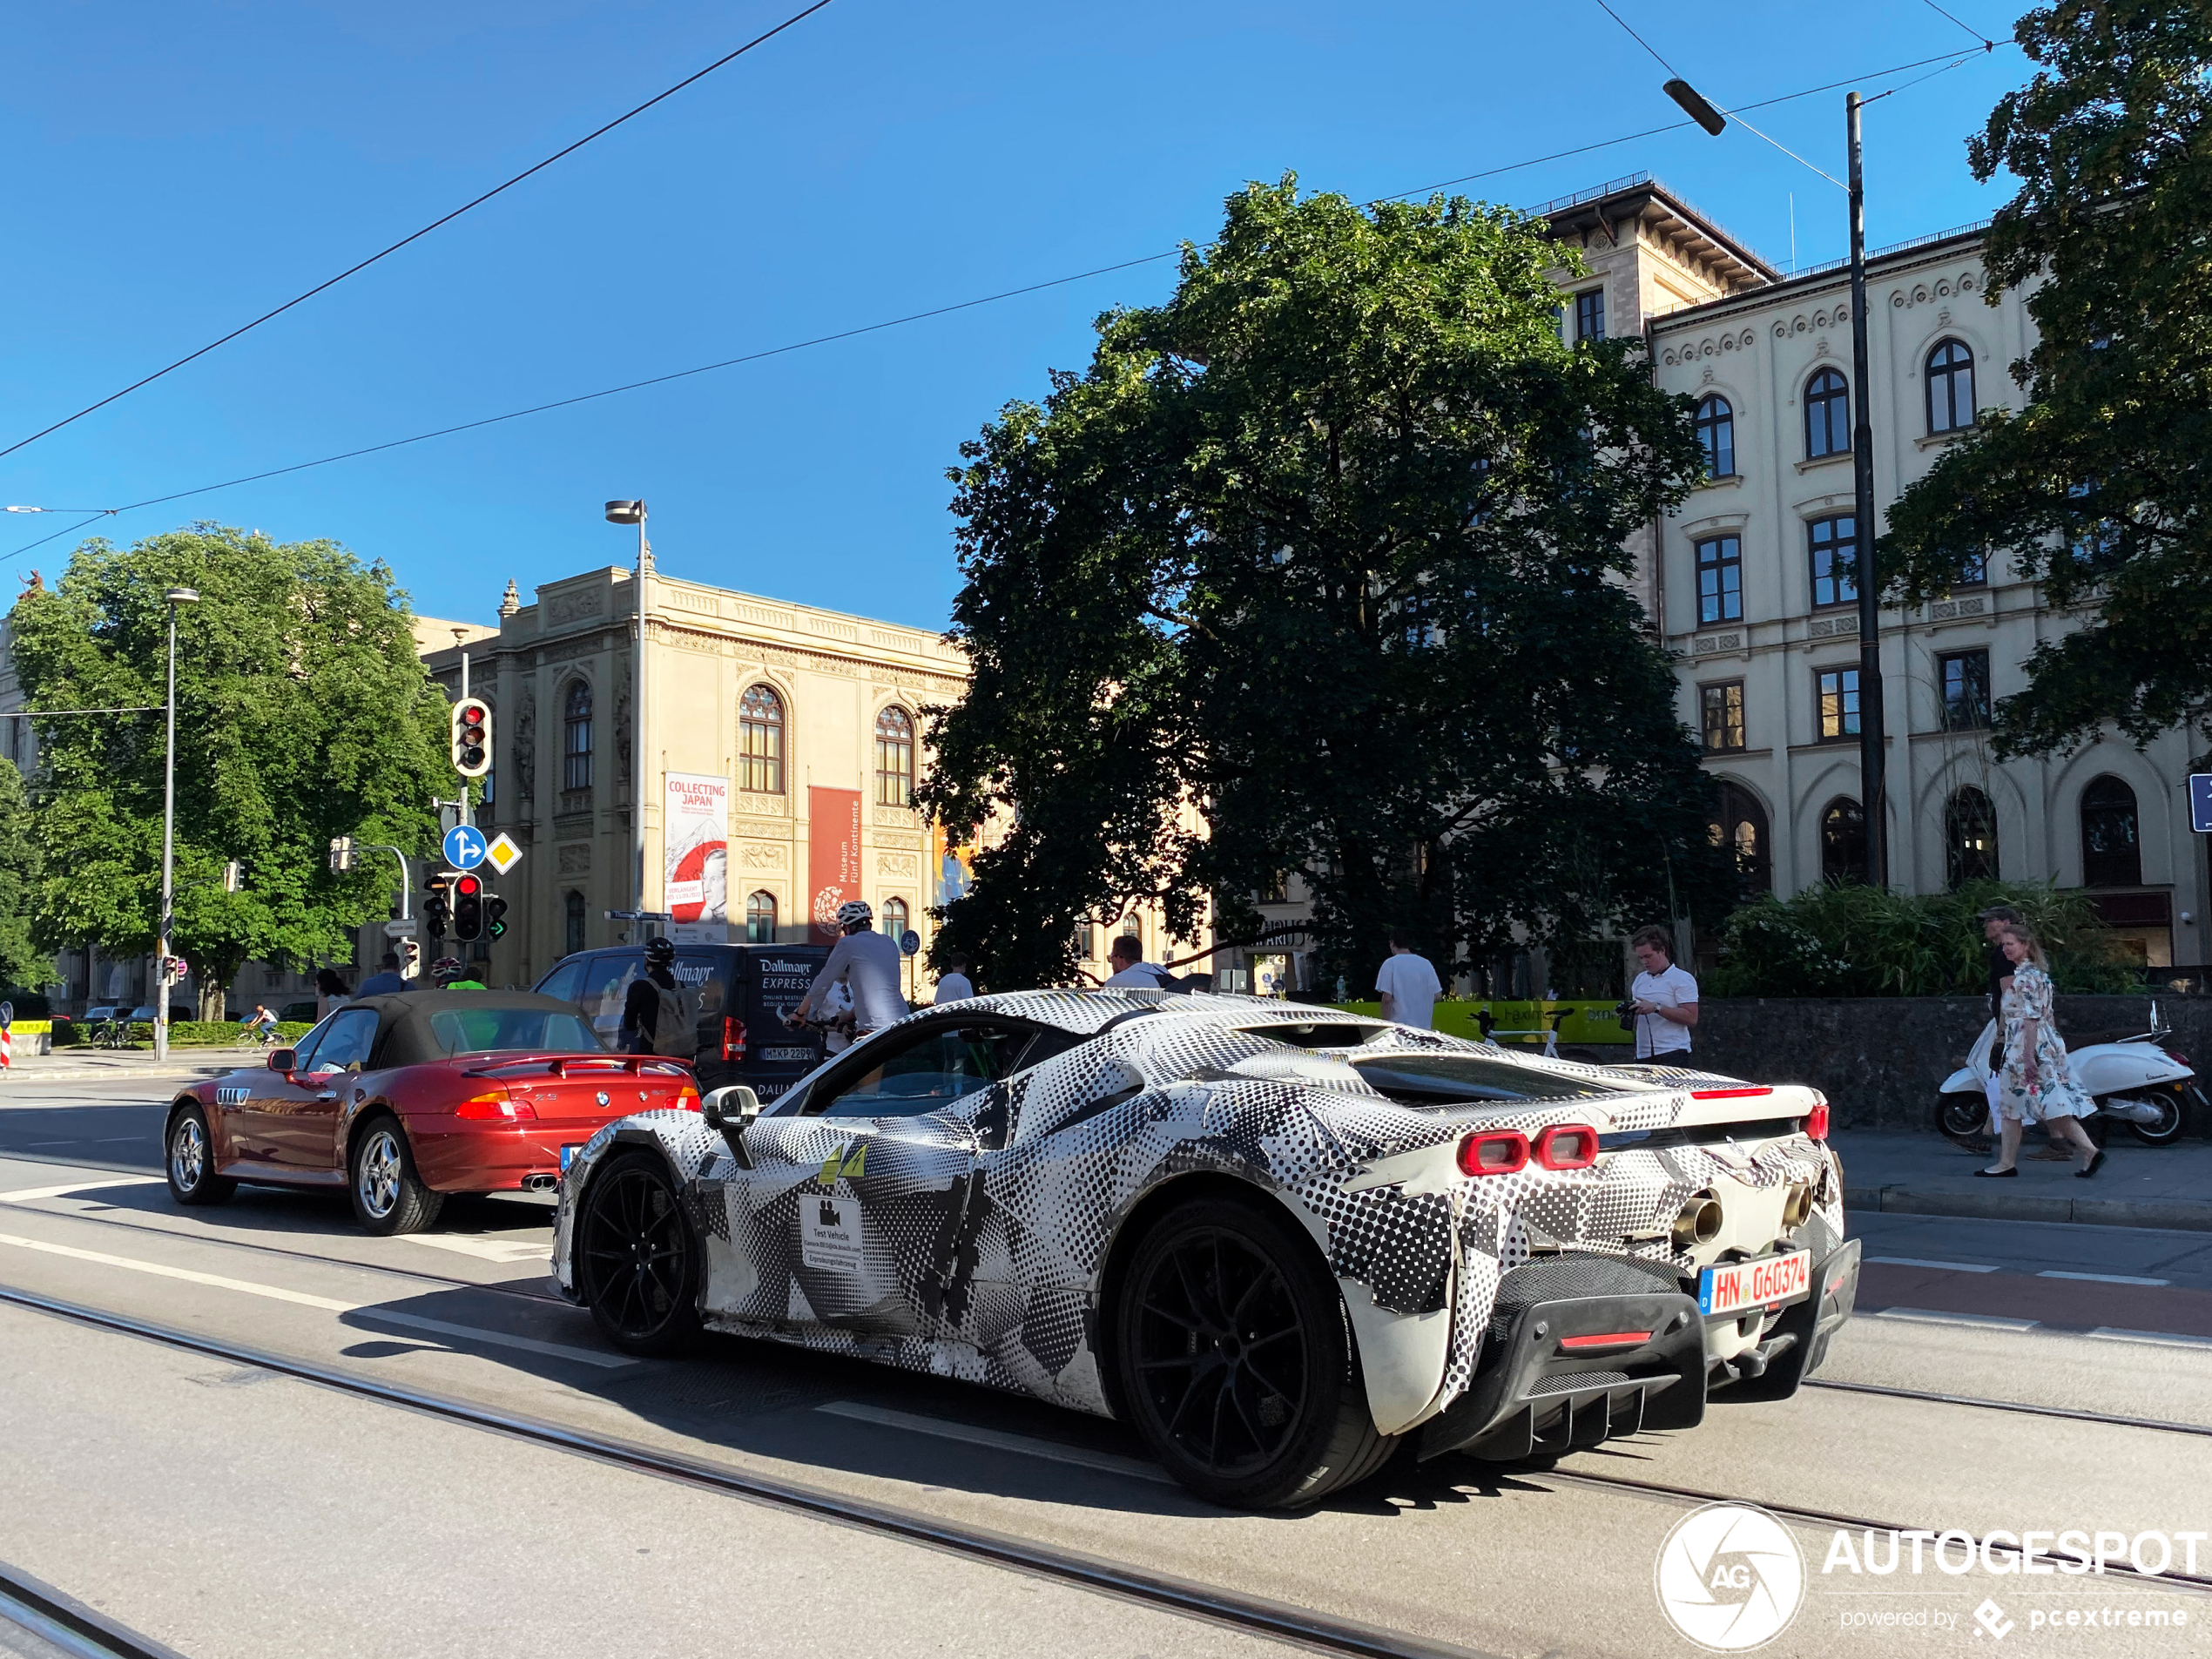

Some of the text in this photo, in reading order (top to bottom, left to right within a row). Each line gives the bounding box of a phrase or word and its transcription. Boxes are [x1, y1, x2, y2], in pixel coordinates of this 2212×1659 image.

[669, 780, 725, 797] COLLECTING
[682, 793, 712, 806] JAPAN
[850, 799, 860, 883] Fünf Kontinente
[839, 841, 847, 882] Museum
[759, 959, 812, 975] Dallmayr
[762, 977, 811, 989] EXPRESS
[813, 1228, 850, 1241] Test Vehicle
[809, 1255, 857, 1270] Erprobungsfahrzeug
[1716, 1256, 1805, 1309] HN 060374
